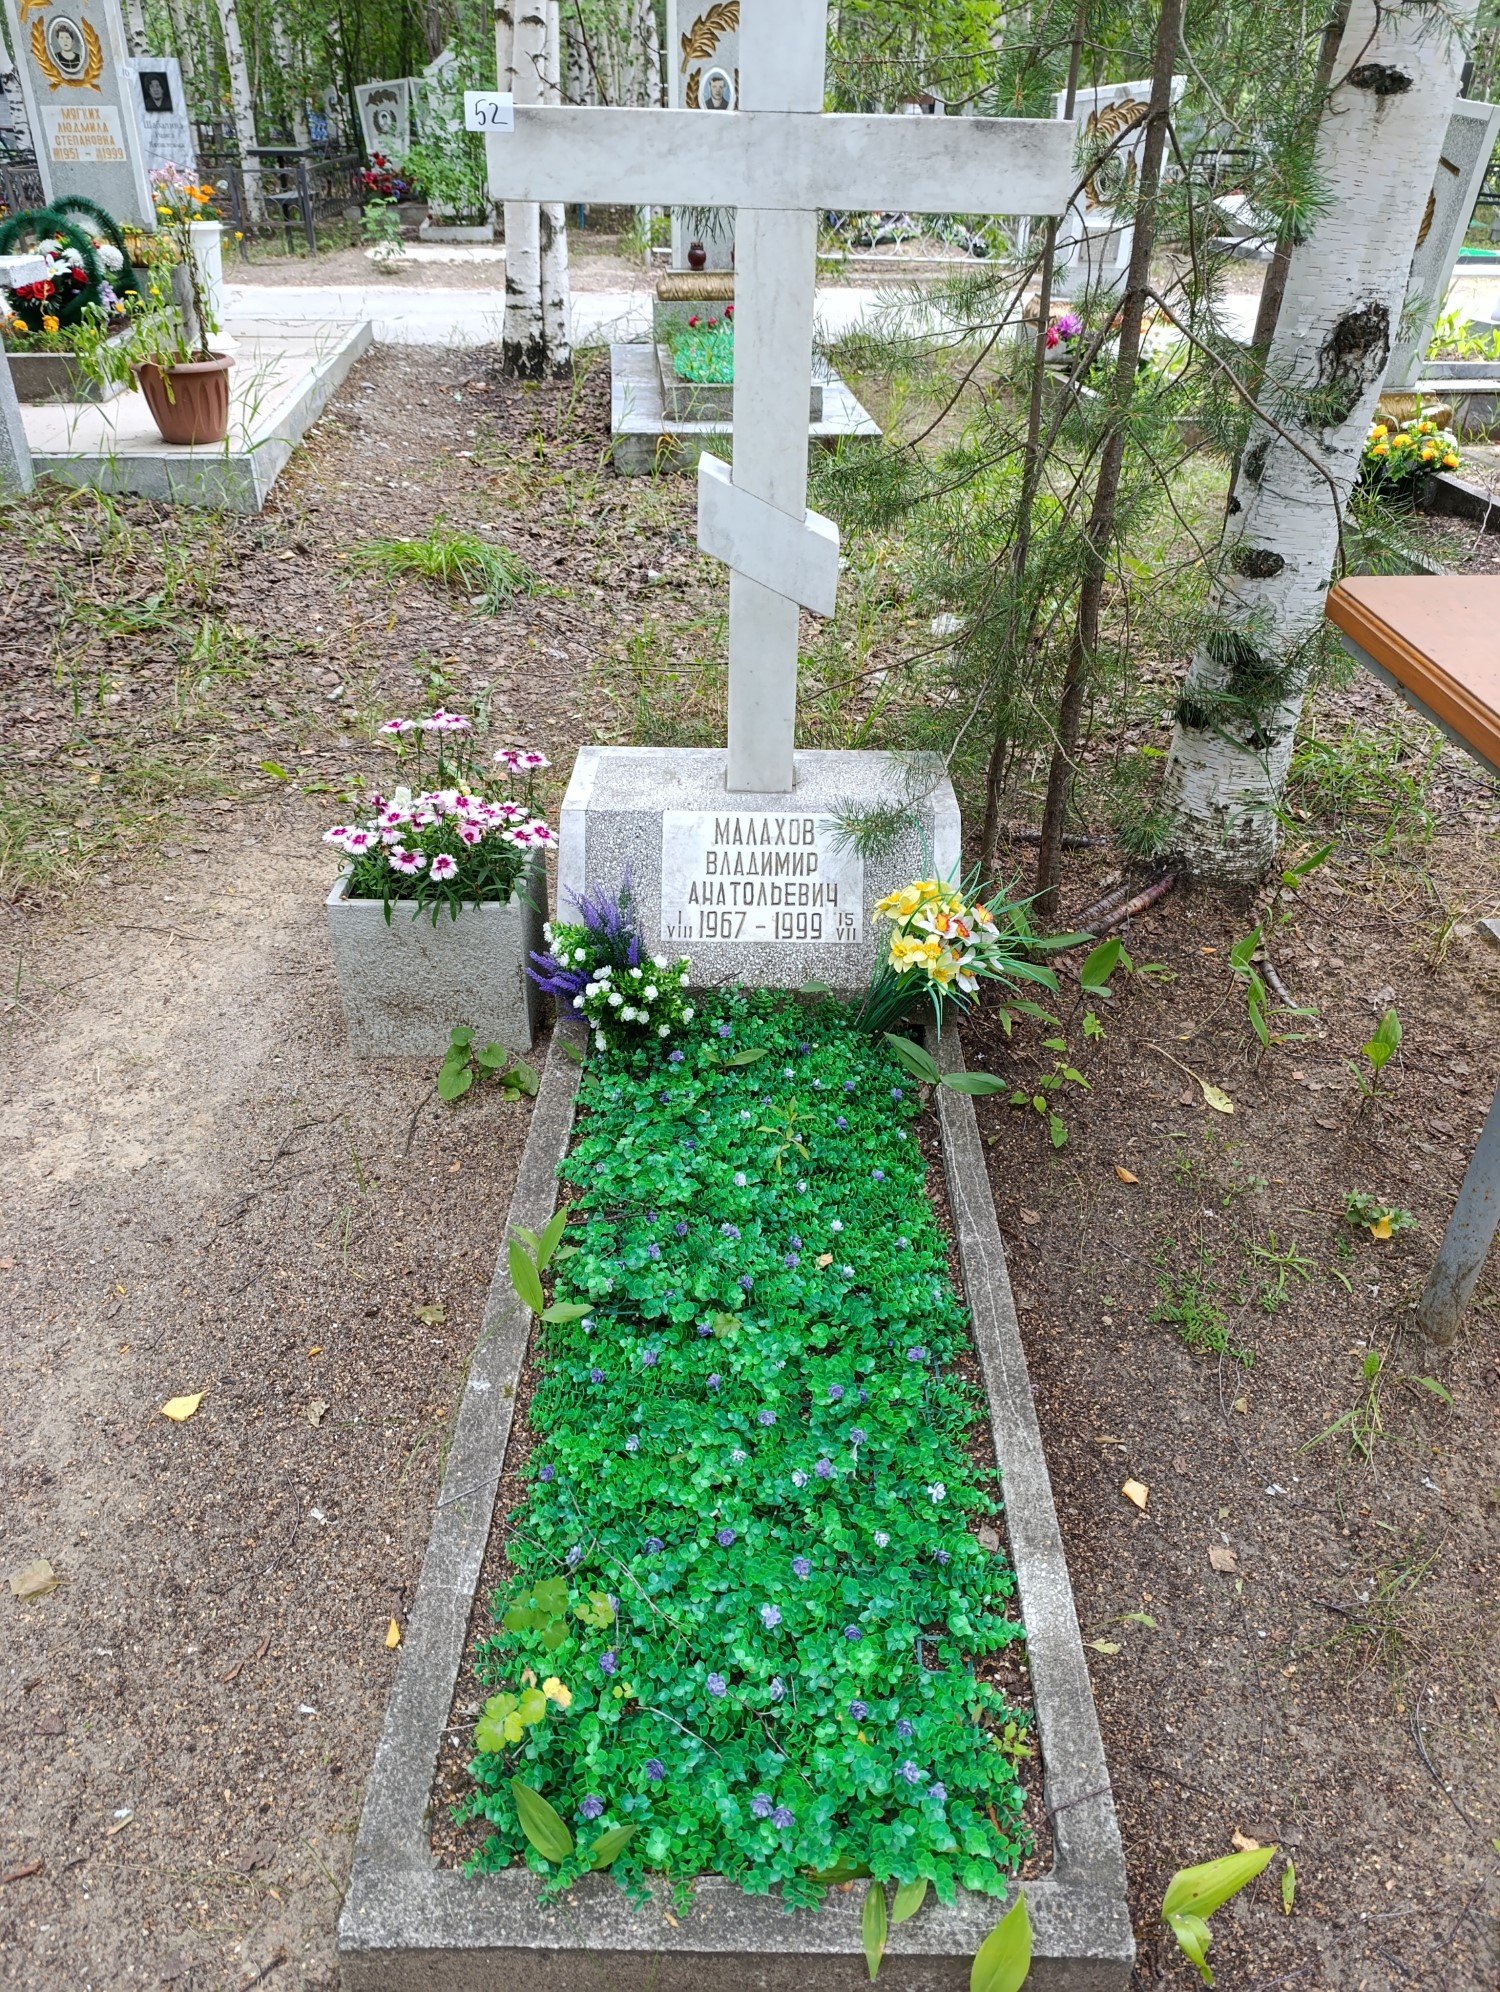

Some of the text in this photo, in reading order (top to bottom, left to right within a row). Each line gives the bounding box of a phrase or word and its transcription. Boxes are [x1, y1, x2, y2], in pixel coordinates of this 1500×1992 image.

[60, 107, 101, 120] МЯГКИХ
[475, 98, 508, 126] 52
[57, 122, 109, 133] ЛЮДМИЛА
[54, 135, 116, 146] СТЕПАНОВНА
[714, 817, 815, 846] МАЛАХОВ
[706, 850, 818, 877] ВЛАДИМИР
[688, 880, 838, 907] АНАТОЛЬЕВИЧ
[699, 911, 747, 939] 1967
[774, 911, 823, 940] 1999
[838, 912, 854, 926] 15
[667, 925, 693, 939] VIII
[836, 927, 857, 941] VII
